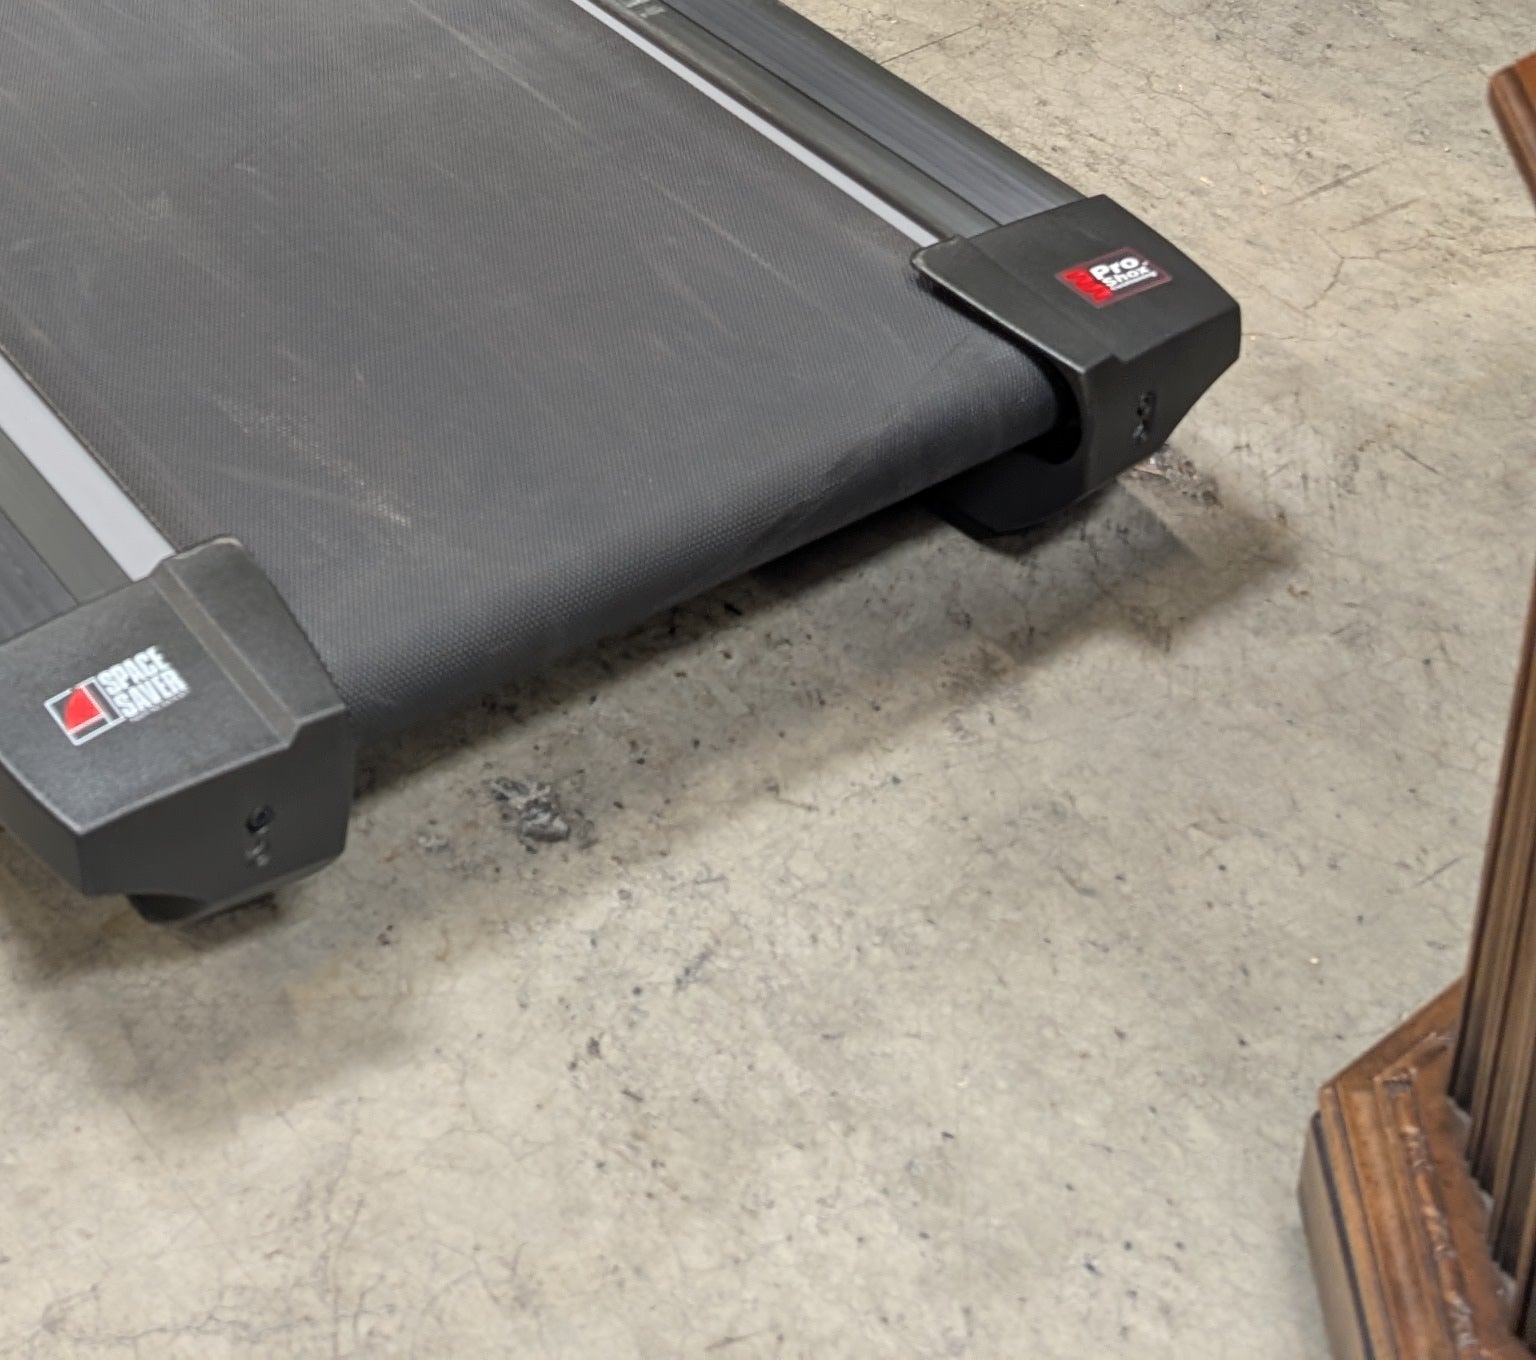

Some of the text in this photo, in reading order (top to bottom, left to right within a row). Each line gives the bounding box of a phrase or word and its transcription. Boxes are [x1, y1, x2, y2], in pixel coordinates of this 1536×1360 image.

[1089, 257, 1139, 281] Pro
[96, 645, 171, 696] SPACE
[114, 669, 191, 718] SAVER
